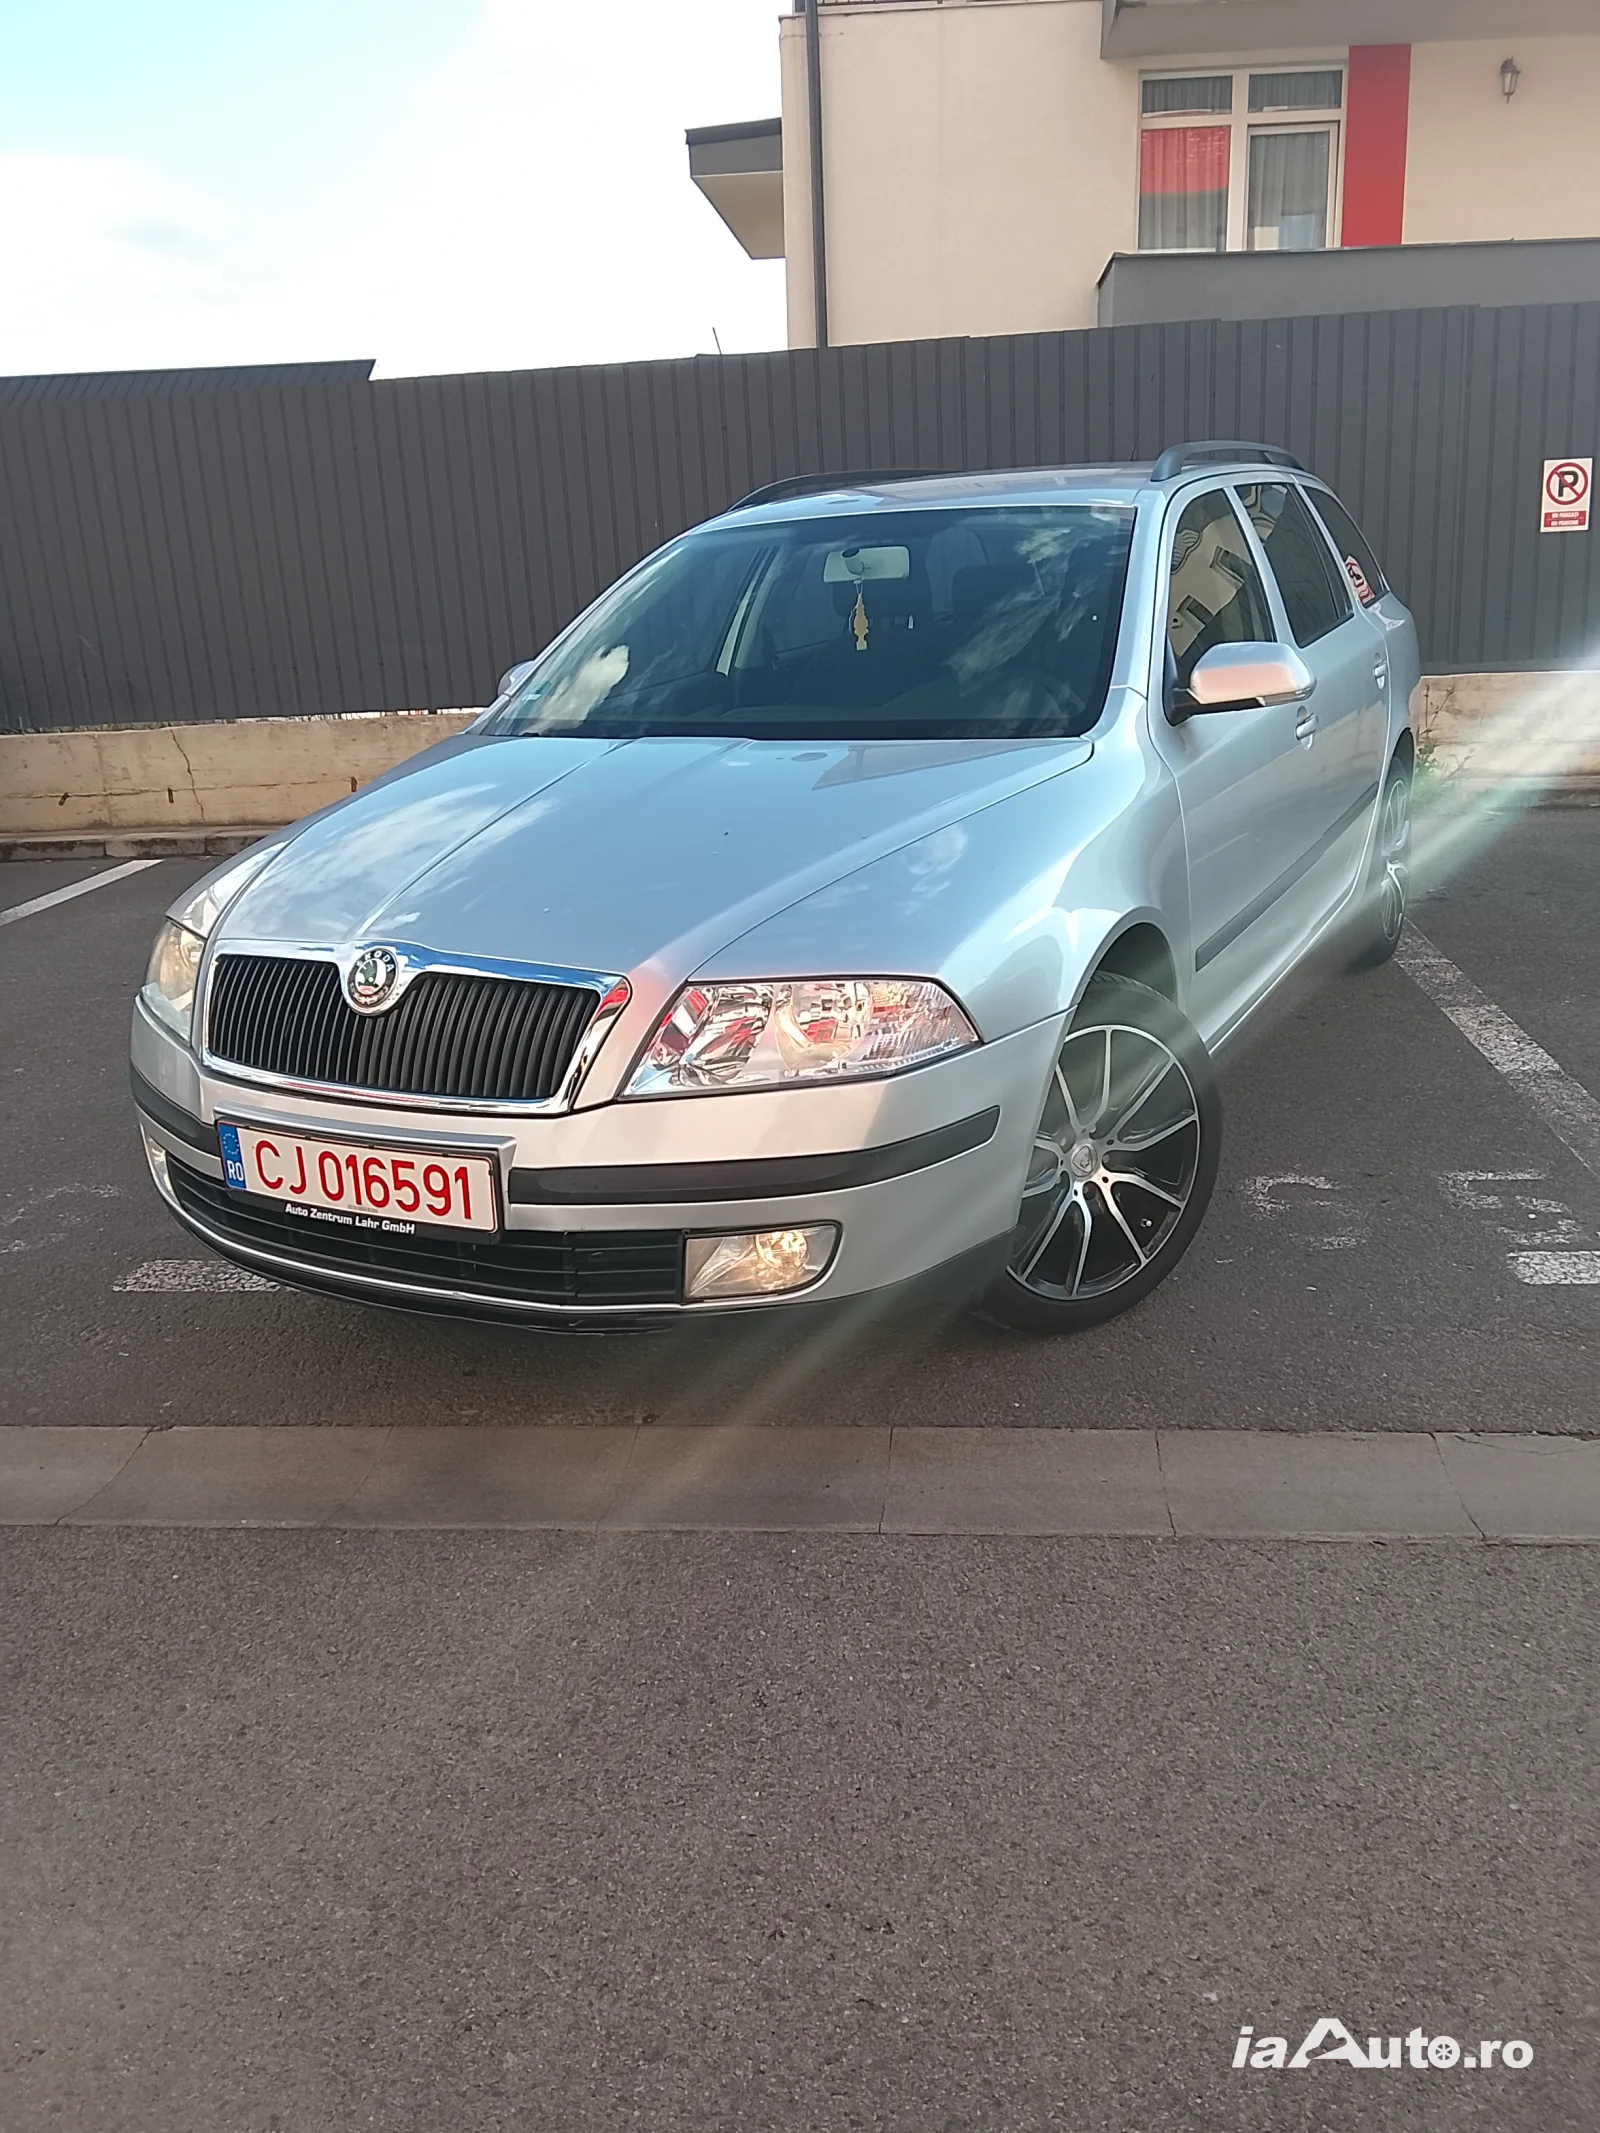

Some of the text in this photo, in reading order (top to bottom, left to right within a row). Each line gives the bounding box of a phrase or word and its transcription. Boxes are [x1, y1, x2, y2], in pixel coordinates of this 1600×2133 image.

[1558, 470, 1579, 497] P
[227, 1159, 244, 1182] RO
[255, 1140, 472, 1220] CJ 016591
[285, 1203, 309, 1217] Auto
[310, 1208, 353, 1225] Zentrum
[355, 1216, 380, 1229] Lahr
[381, 1220, 415, 1234] GmbH
